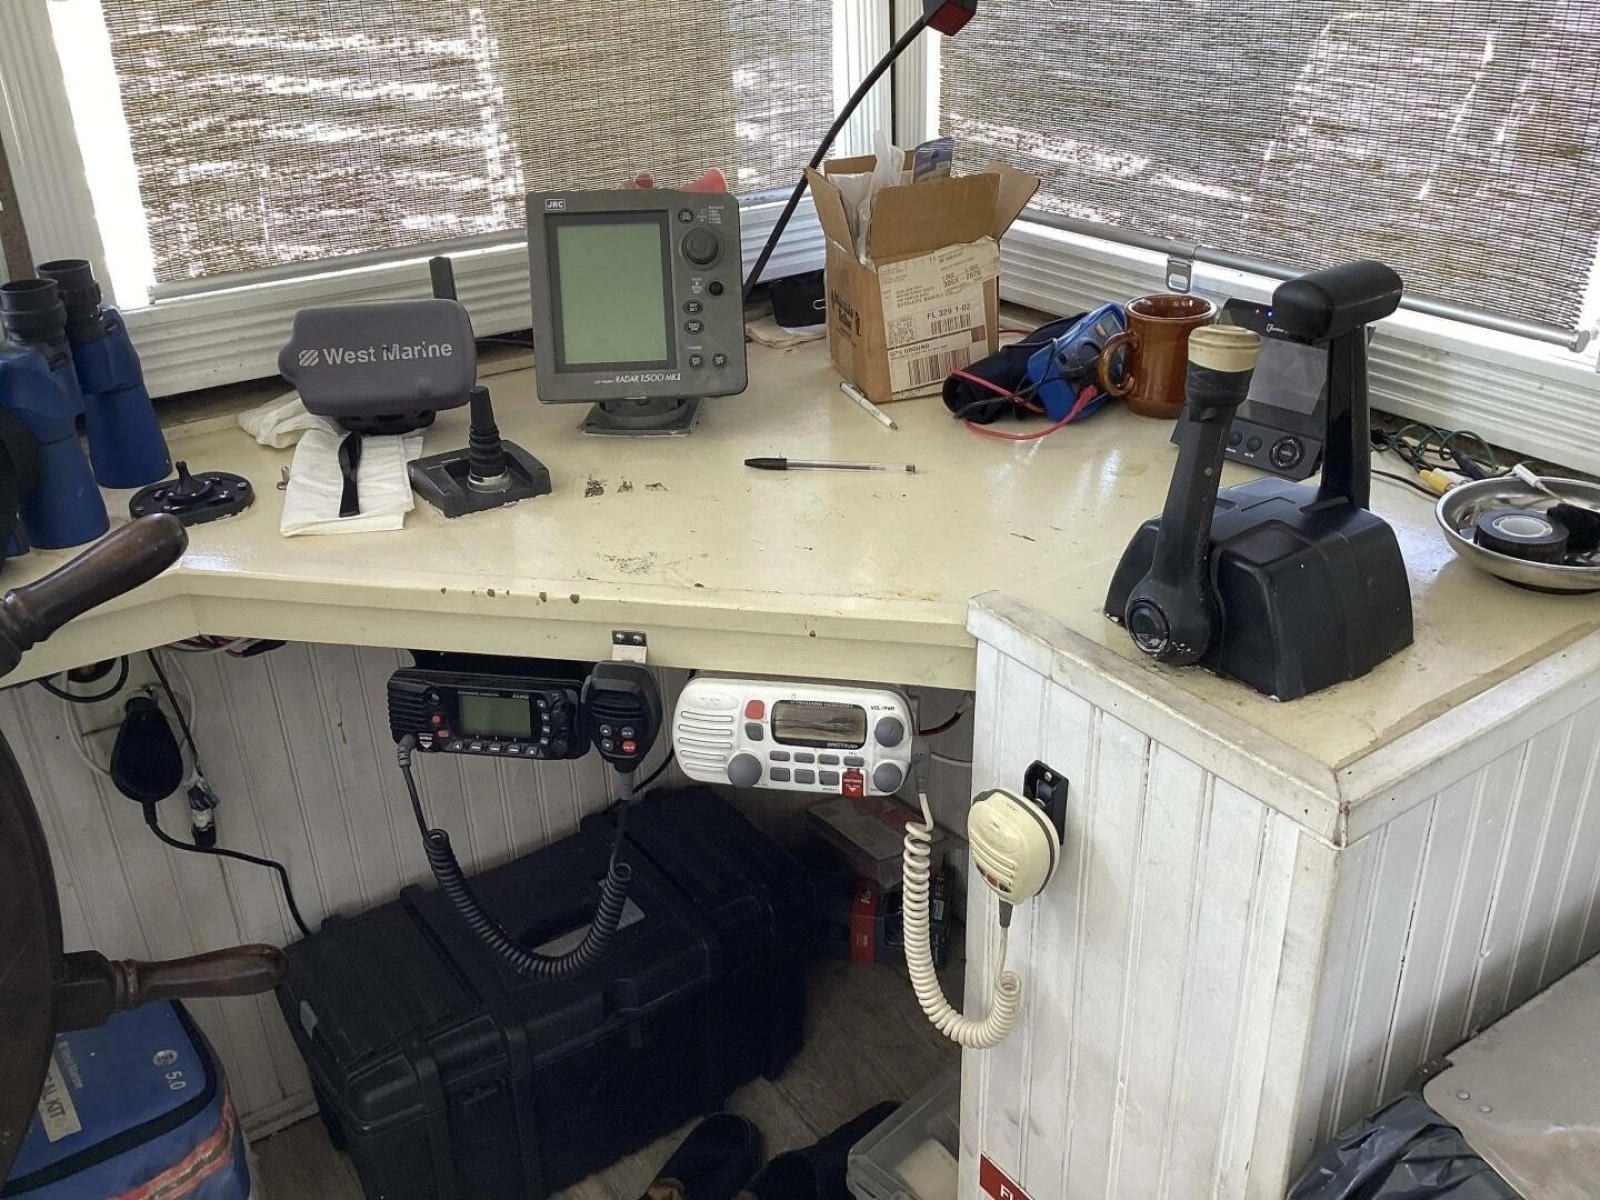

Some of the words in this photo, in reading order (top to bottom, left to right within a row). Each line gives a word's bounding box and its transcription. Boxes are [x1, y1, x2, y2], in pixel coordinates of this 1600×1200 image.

[547, 200, 563, 209] JRC
[938, 306, 952, 316] 329
[323, 346, 376, 365] West
[381, 341, 453, 362] Marine
[904, 343, 930, 353] GROUND
[616, 375, 639, 383] RADAR
[640, 373, 664, 382] 1500
[44, 1098, 67, 1119] KIT
